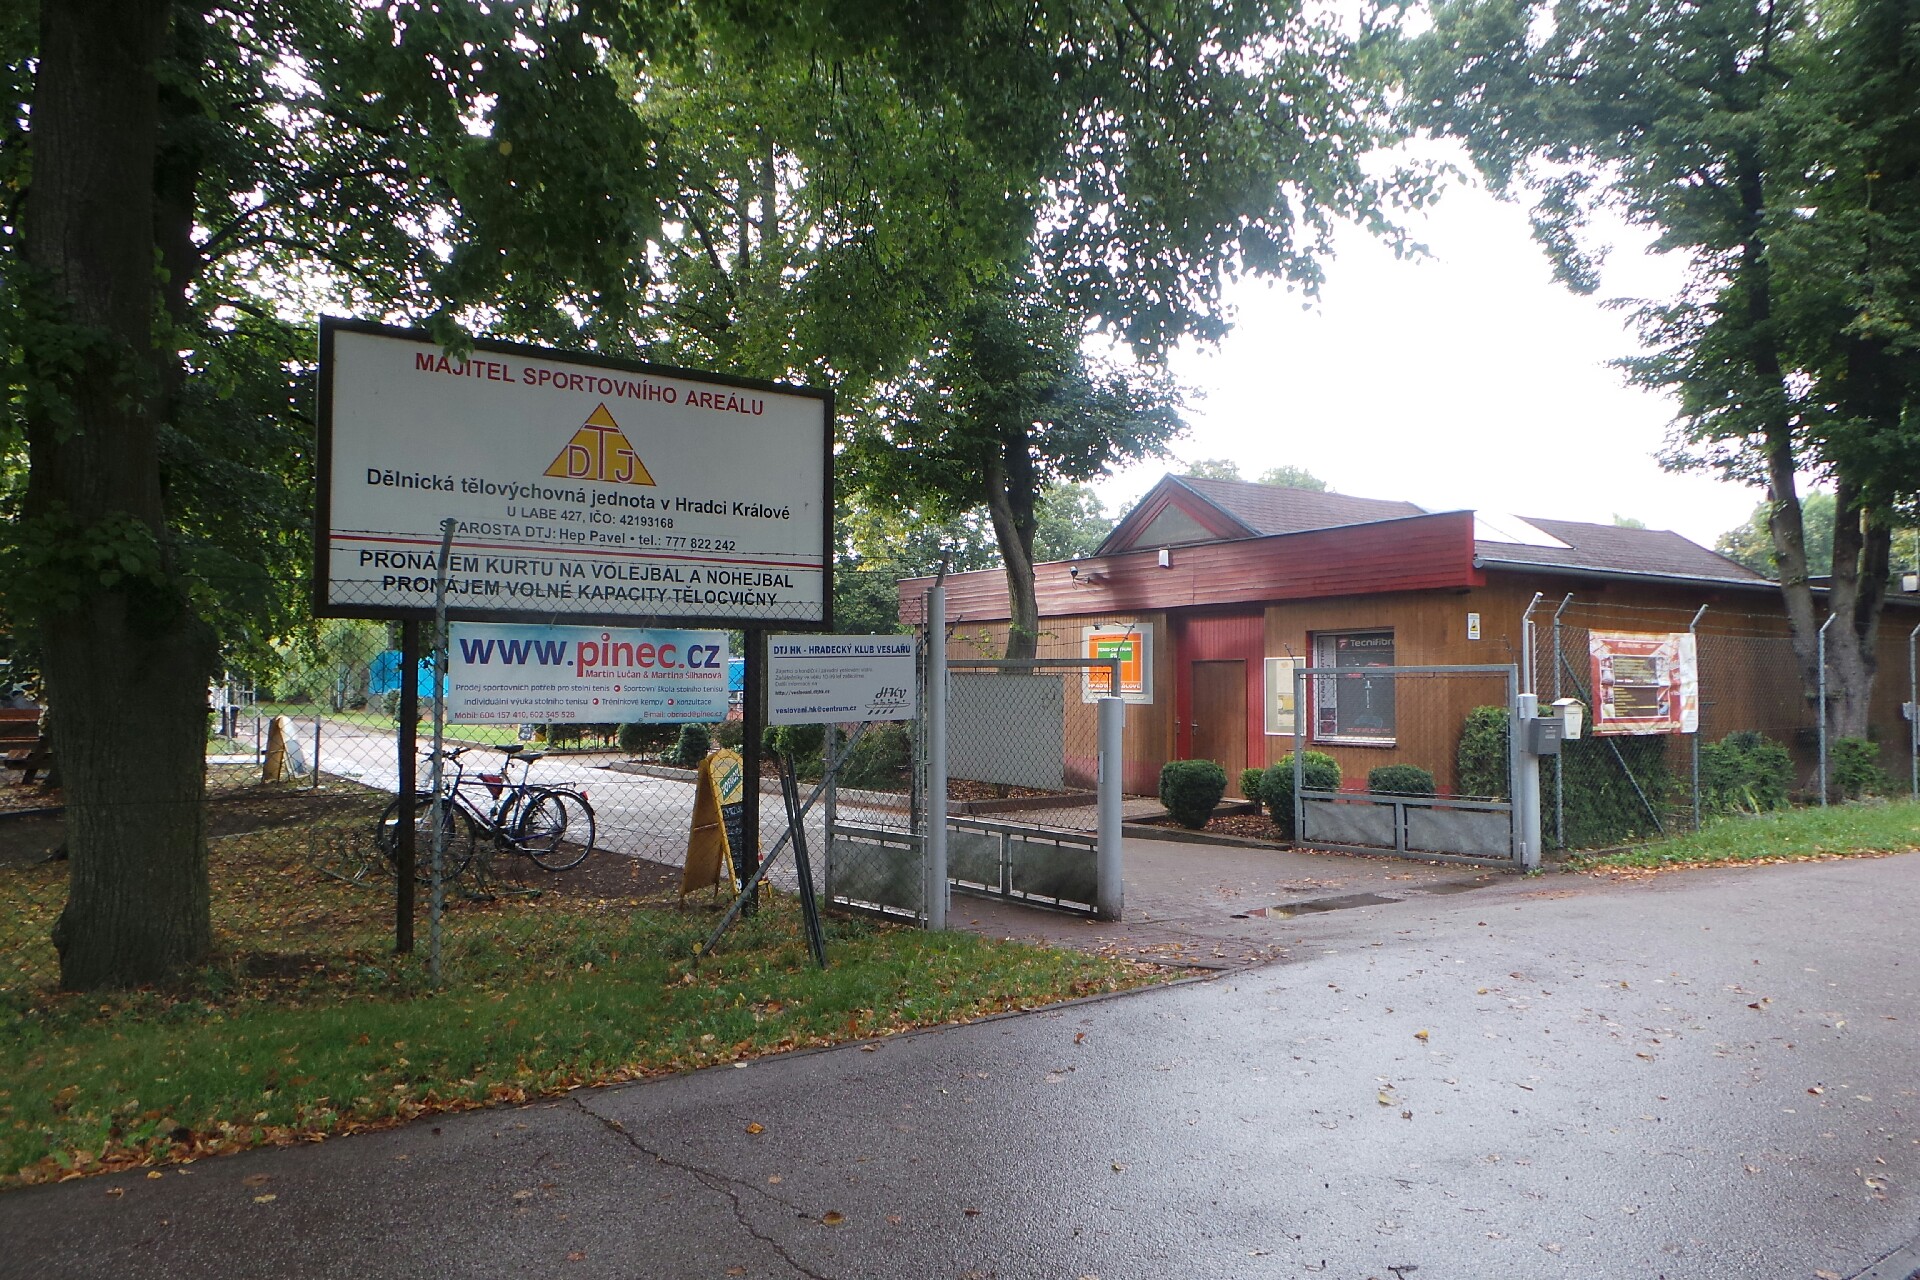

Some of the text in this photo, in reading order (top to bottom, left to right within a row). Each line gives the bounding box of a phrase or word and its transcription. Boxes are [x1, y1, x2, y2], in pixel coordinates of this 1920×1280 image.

[415, 353, 764, 416] MAJITEL SPORTOVNÍHO AREÁLU
[567, 424, 635, 482] DTJ
[367, 468, 790, 520] Dělnická tělovýchovná jednota v Hradci Králové
[506, 506, 674, 528] U LABE 427, IČO: 42193168
[440, 519, 736, 551] SAROSTA DTJ: Hep Pavel tel.: 777 822 242
[360, 550, 794, 588] PRONÁEM KURTU NA VOLEJBAL A NOHEJBAL
[506, 580, 572, 599] VOLNÉ
[578, 584, 668, 603] KAPACITY
[672, 585, 778, 607] TĚLOCVIČNY
[459, 632, 720, 678] www.pinec.cz
[774, 646, 788, 655] DTJ
[790, 646, 802, 654] HK
[808, 644, 852, 654] HRADECKÝ
[854, 645, 874, 654] KLUB
[456, 684, 481, 692] Prodej
[530, 684, 556, 692] potřeb
[586, 670, 614, 678] Martin
[617, 670, 641, 679] Lučan
[643, 671, 649, 679] &
[652, 671, 684, 679] Martina
[510, 698, 533, 706] výuka
[640, 698, 664, 706] kempy
